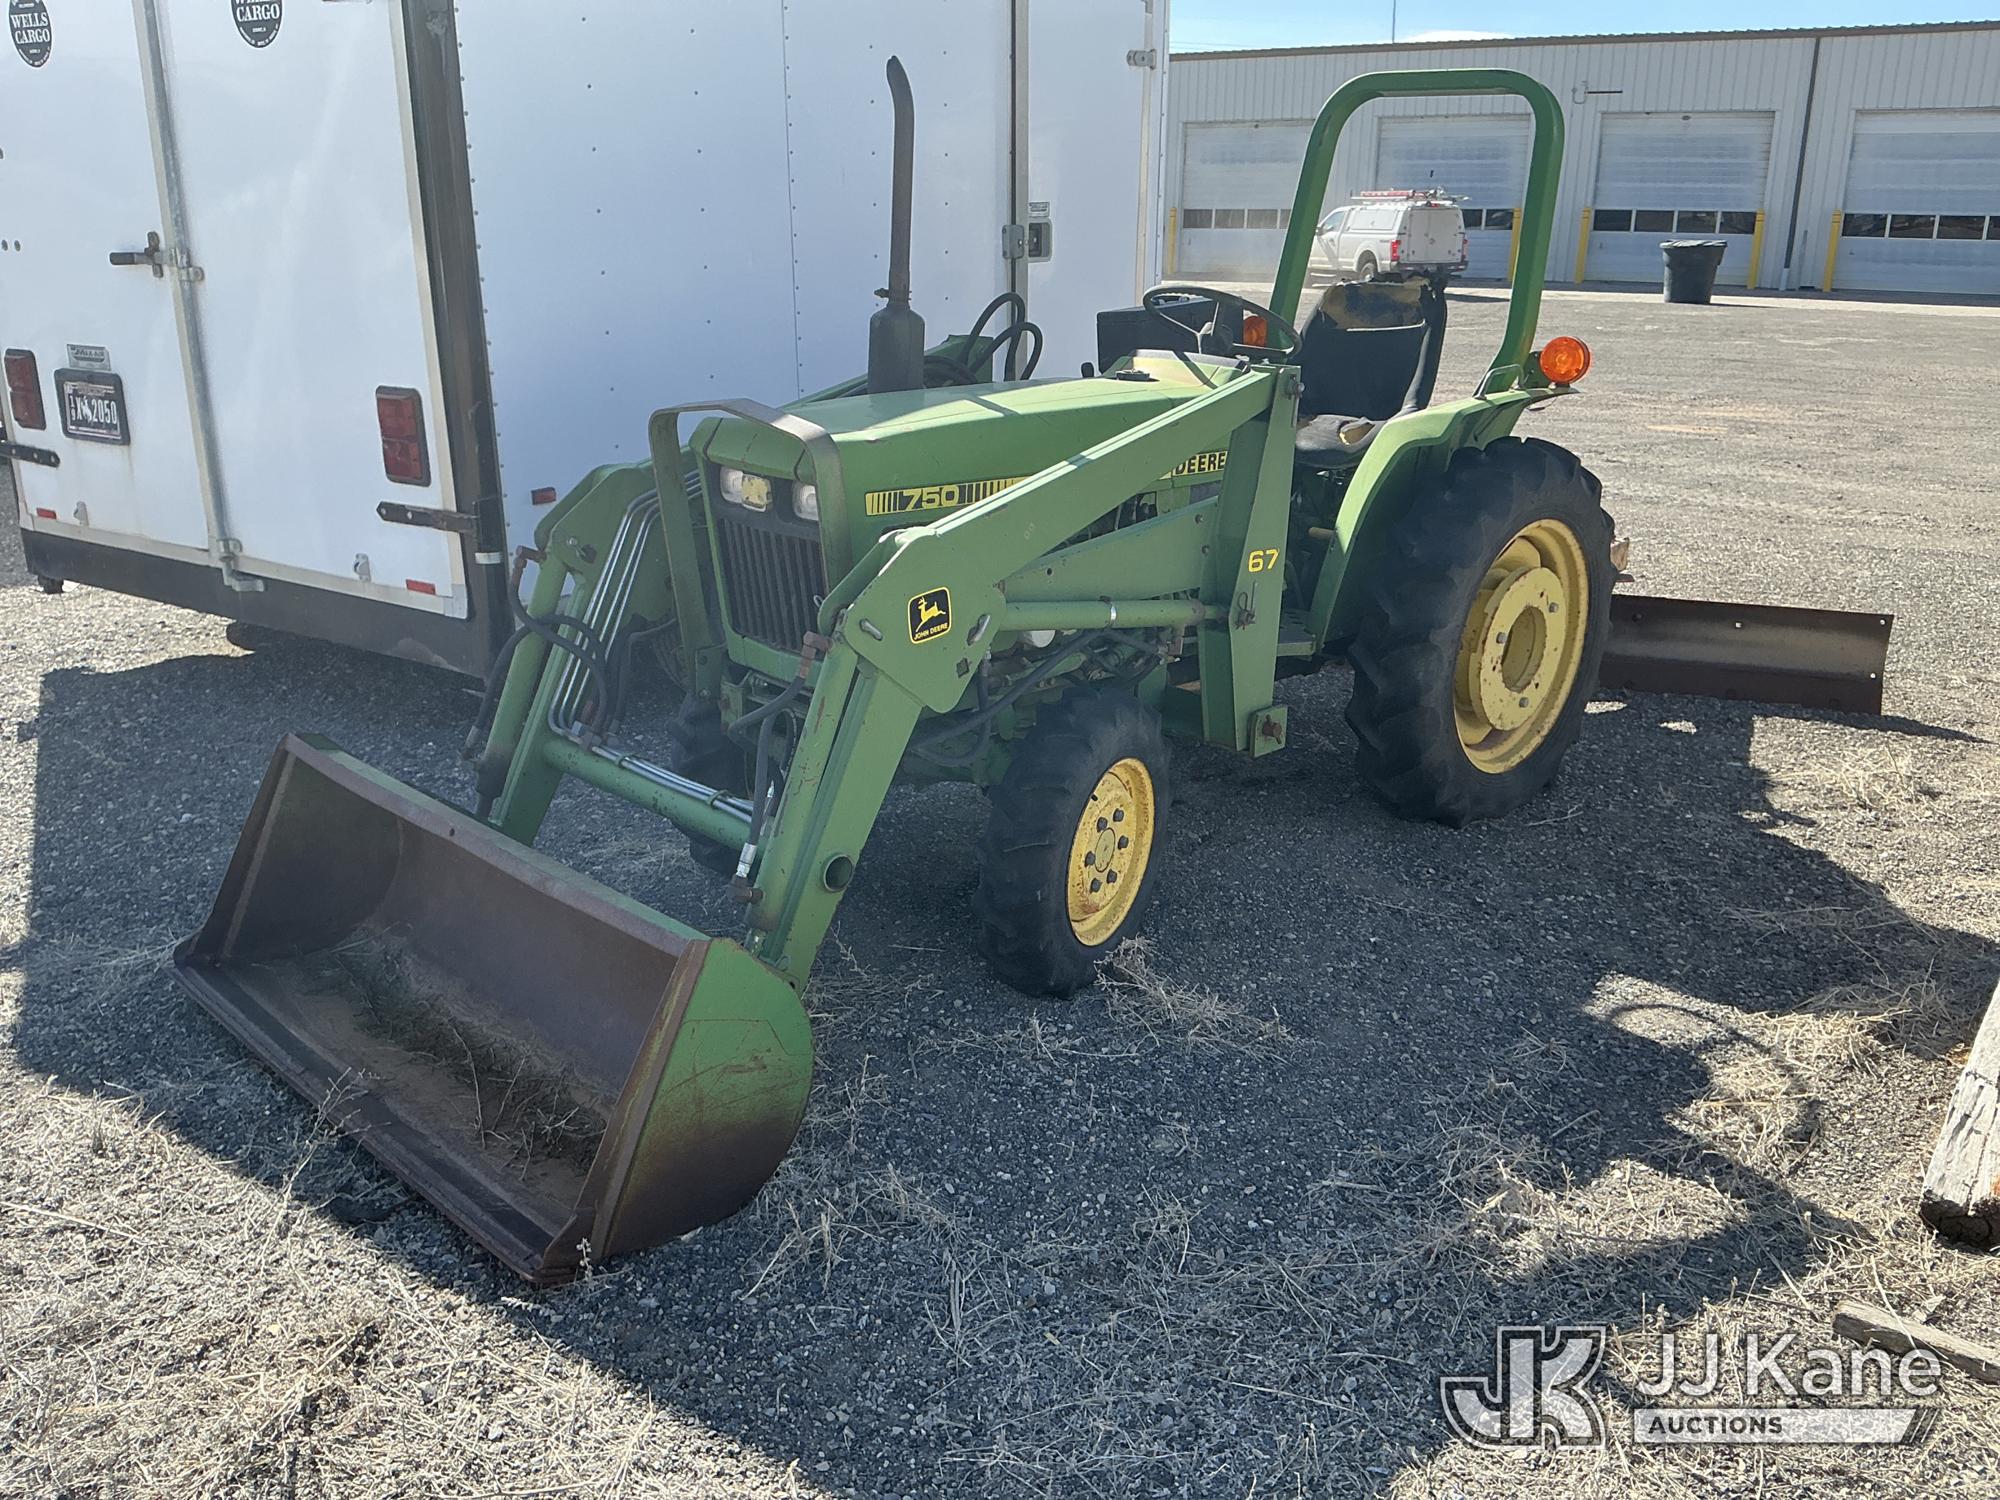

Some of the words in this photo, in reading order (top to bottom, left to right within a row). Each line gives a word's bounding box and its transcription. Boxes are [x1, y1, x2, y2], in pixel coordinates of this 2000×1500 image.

[10, 12, 49, 29] WELLS
[236, 3, 280, 22] CARGO
[15, 28, 51, 44] CARGO
[1175, 452, 1226, 475] DEERE
[903, 484, 960, 511] 750
[1248, 548, 1280, 573] 67
[914, 629, 929, 640] JOHN
[929, 622, 948, 634] DEERE
